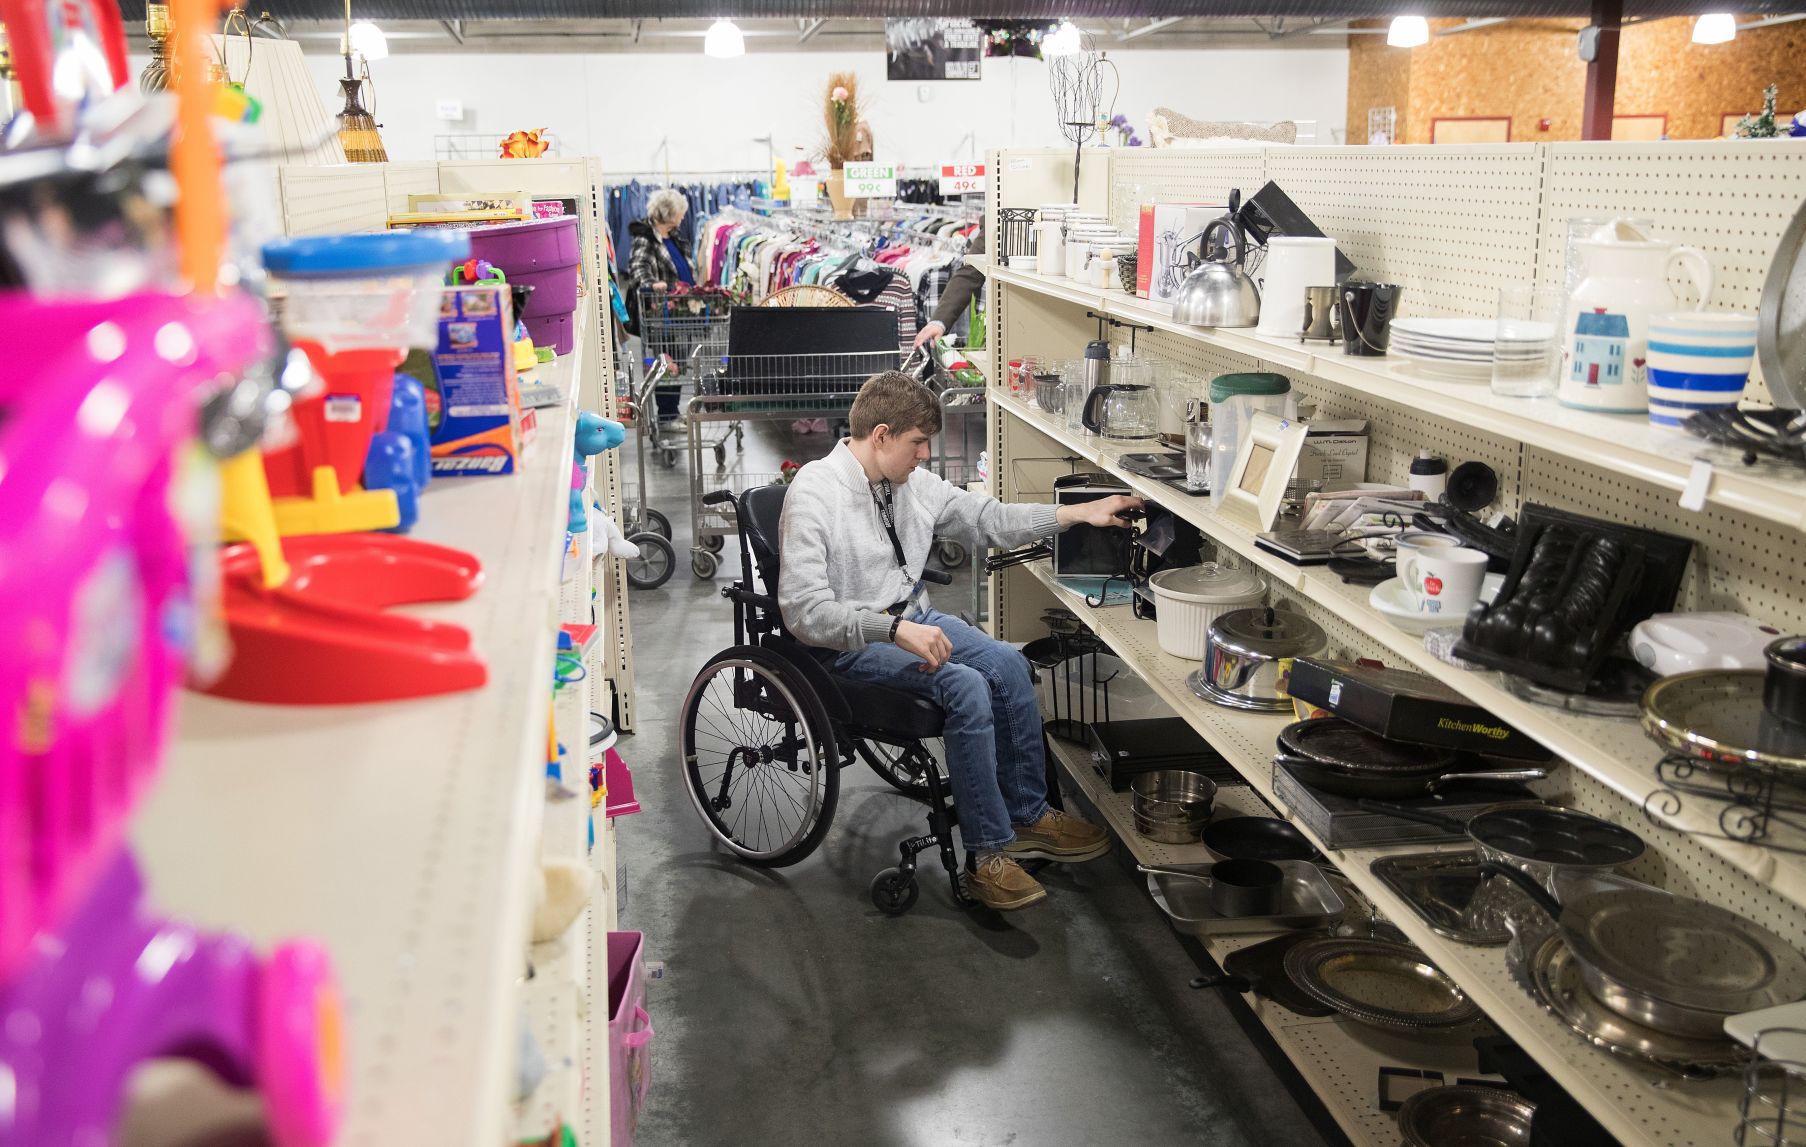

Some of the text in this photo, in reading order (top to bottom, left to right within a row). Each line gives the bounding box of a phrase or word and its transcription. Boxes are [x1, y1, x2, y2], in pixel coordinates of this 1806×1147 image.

[850, 167, 889, 178] GREEN
[953, 165, 976, 177] RED
[1437, 717, 1510, 739] KitchenWorthy
